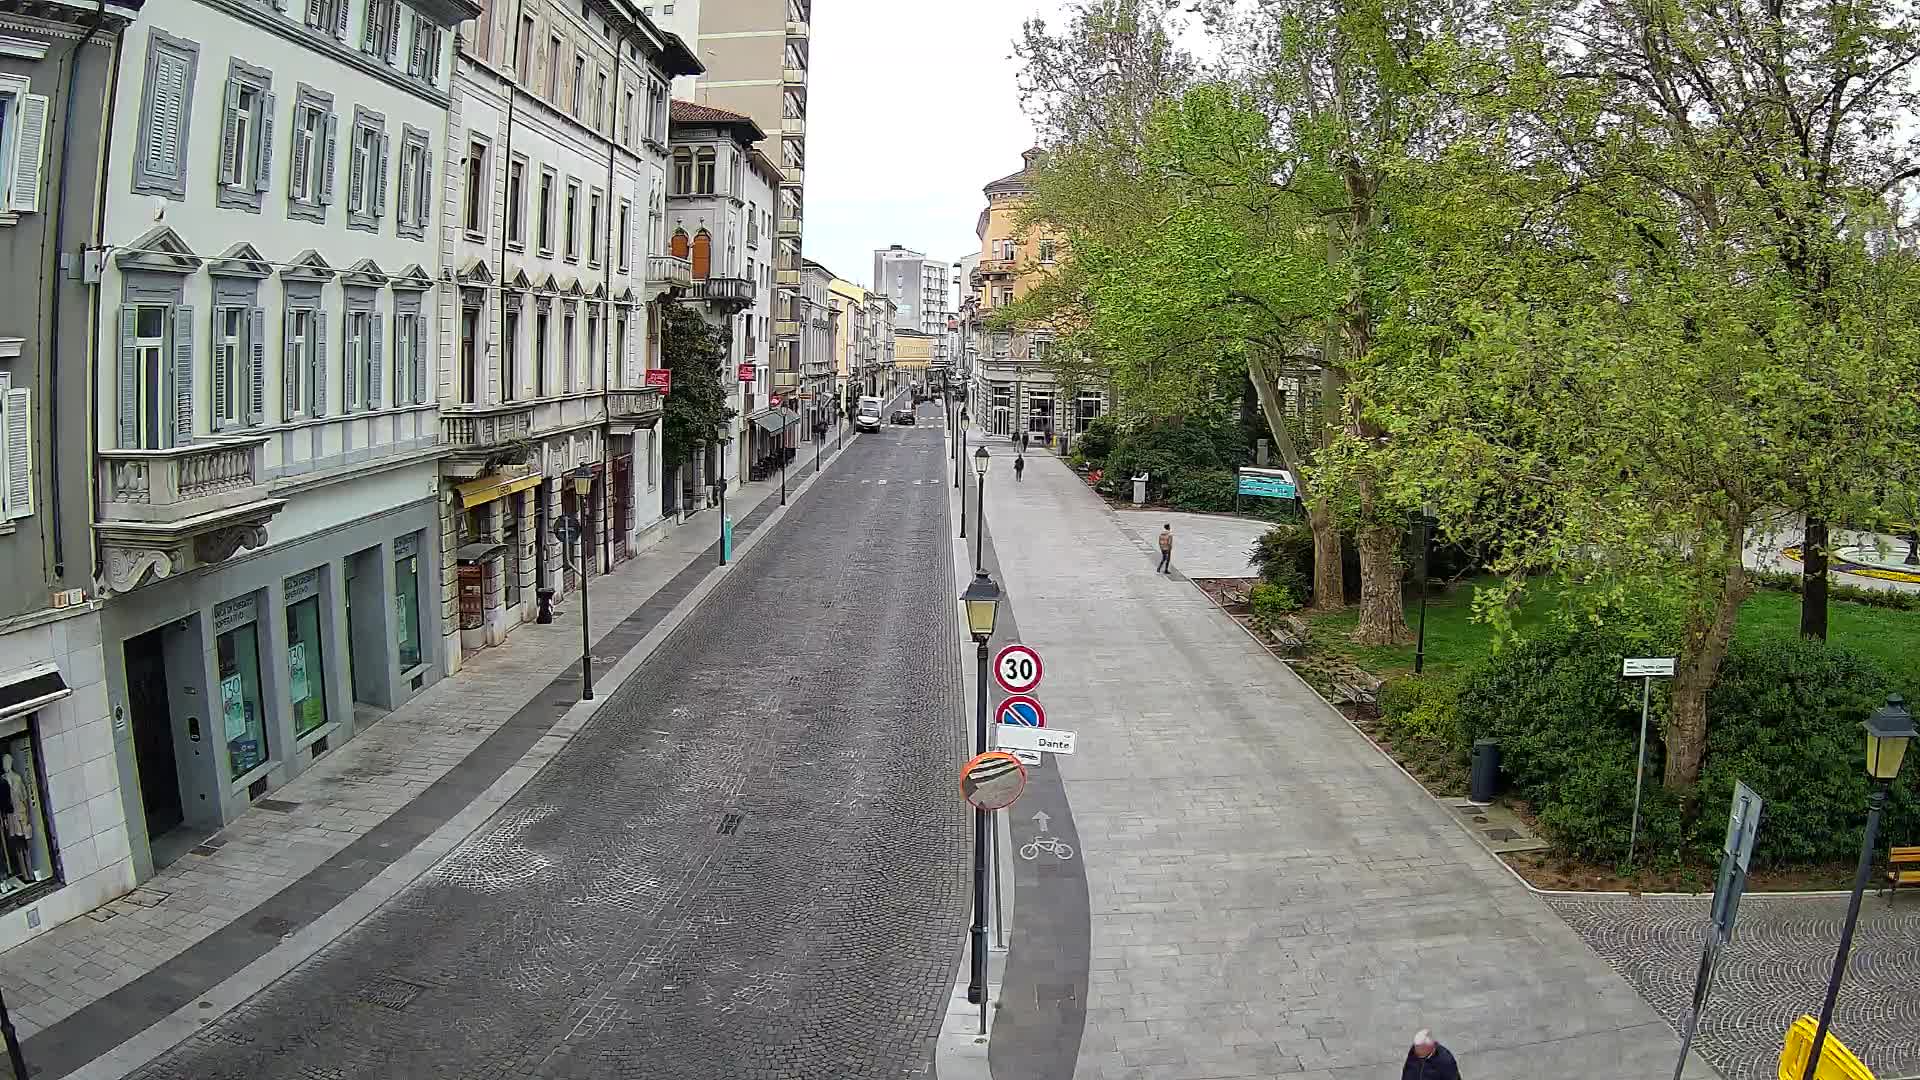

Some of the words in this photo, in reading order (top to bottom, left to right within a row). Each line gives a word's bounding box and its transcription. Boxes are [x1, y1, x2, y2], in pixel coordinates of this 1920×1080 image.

[1005, 659, 1032, 680] 30
[222, 677, 240, 700] 130
[1038, 738, 1070, 749] Dante
